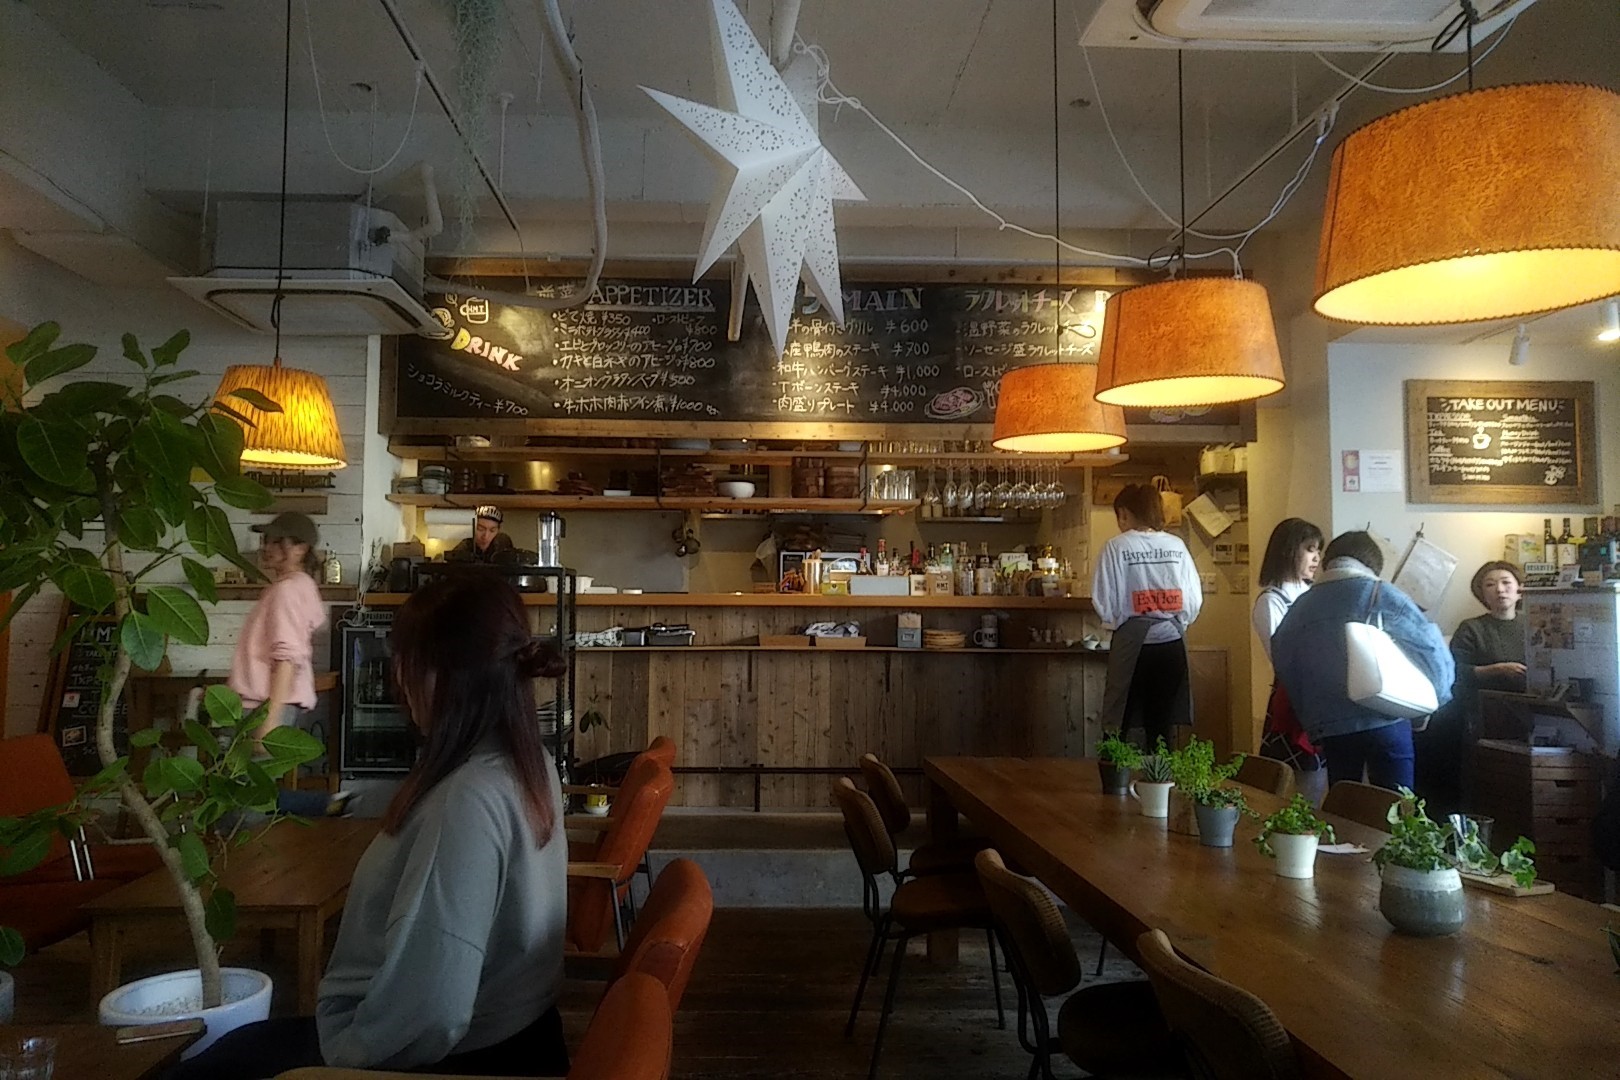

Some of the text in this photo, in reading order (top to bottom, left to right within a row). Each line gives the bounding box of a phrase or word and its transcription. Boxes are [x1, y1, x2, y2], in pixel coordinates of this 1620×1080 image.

[588, 285, 714, 307] APPETIZER
[841, 287, 926, 312] MAIN
[451, 327, 523, 371] DRINK
[1449, 398, 1558, 412] TAKE OUT MENU
[1154, 548, 1184, 559] Horror
